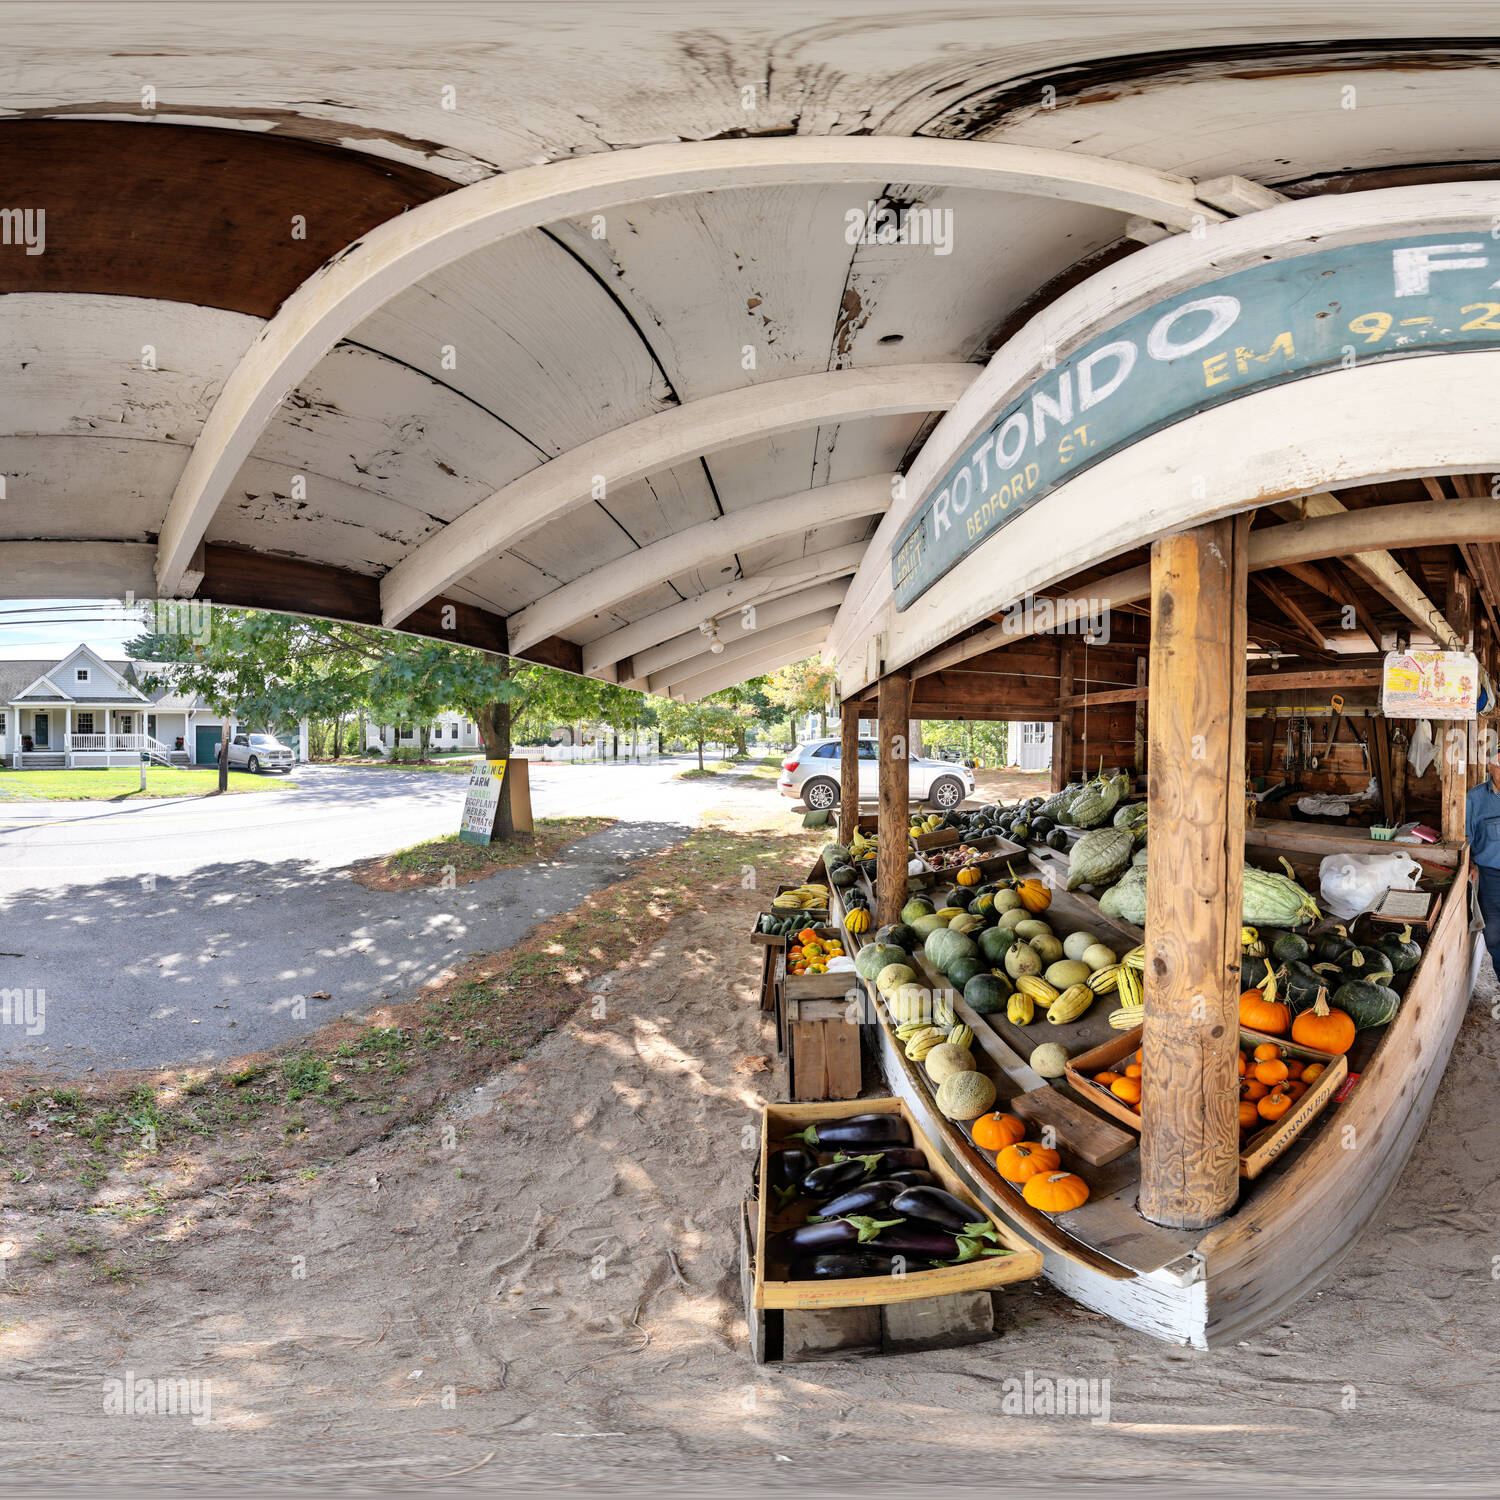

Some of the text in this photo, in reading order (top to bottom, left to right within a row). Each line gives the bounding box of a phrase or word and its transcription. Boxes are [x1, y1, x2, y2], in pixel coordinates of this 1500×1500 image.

[1203, 332, 1296, 388] EM
[932, 295, 1240, 541] ROTONDO
[967, 463, 1040, 540] BEDFORD
[469, 776, 490, 787] FARM
[472, 765, 504, 775] ORGANIC
